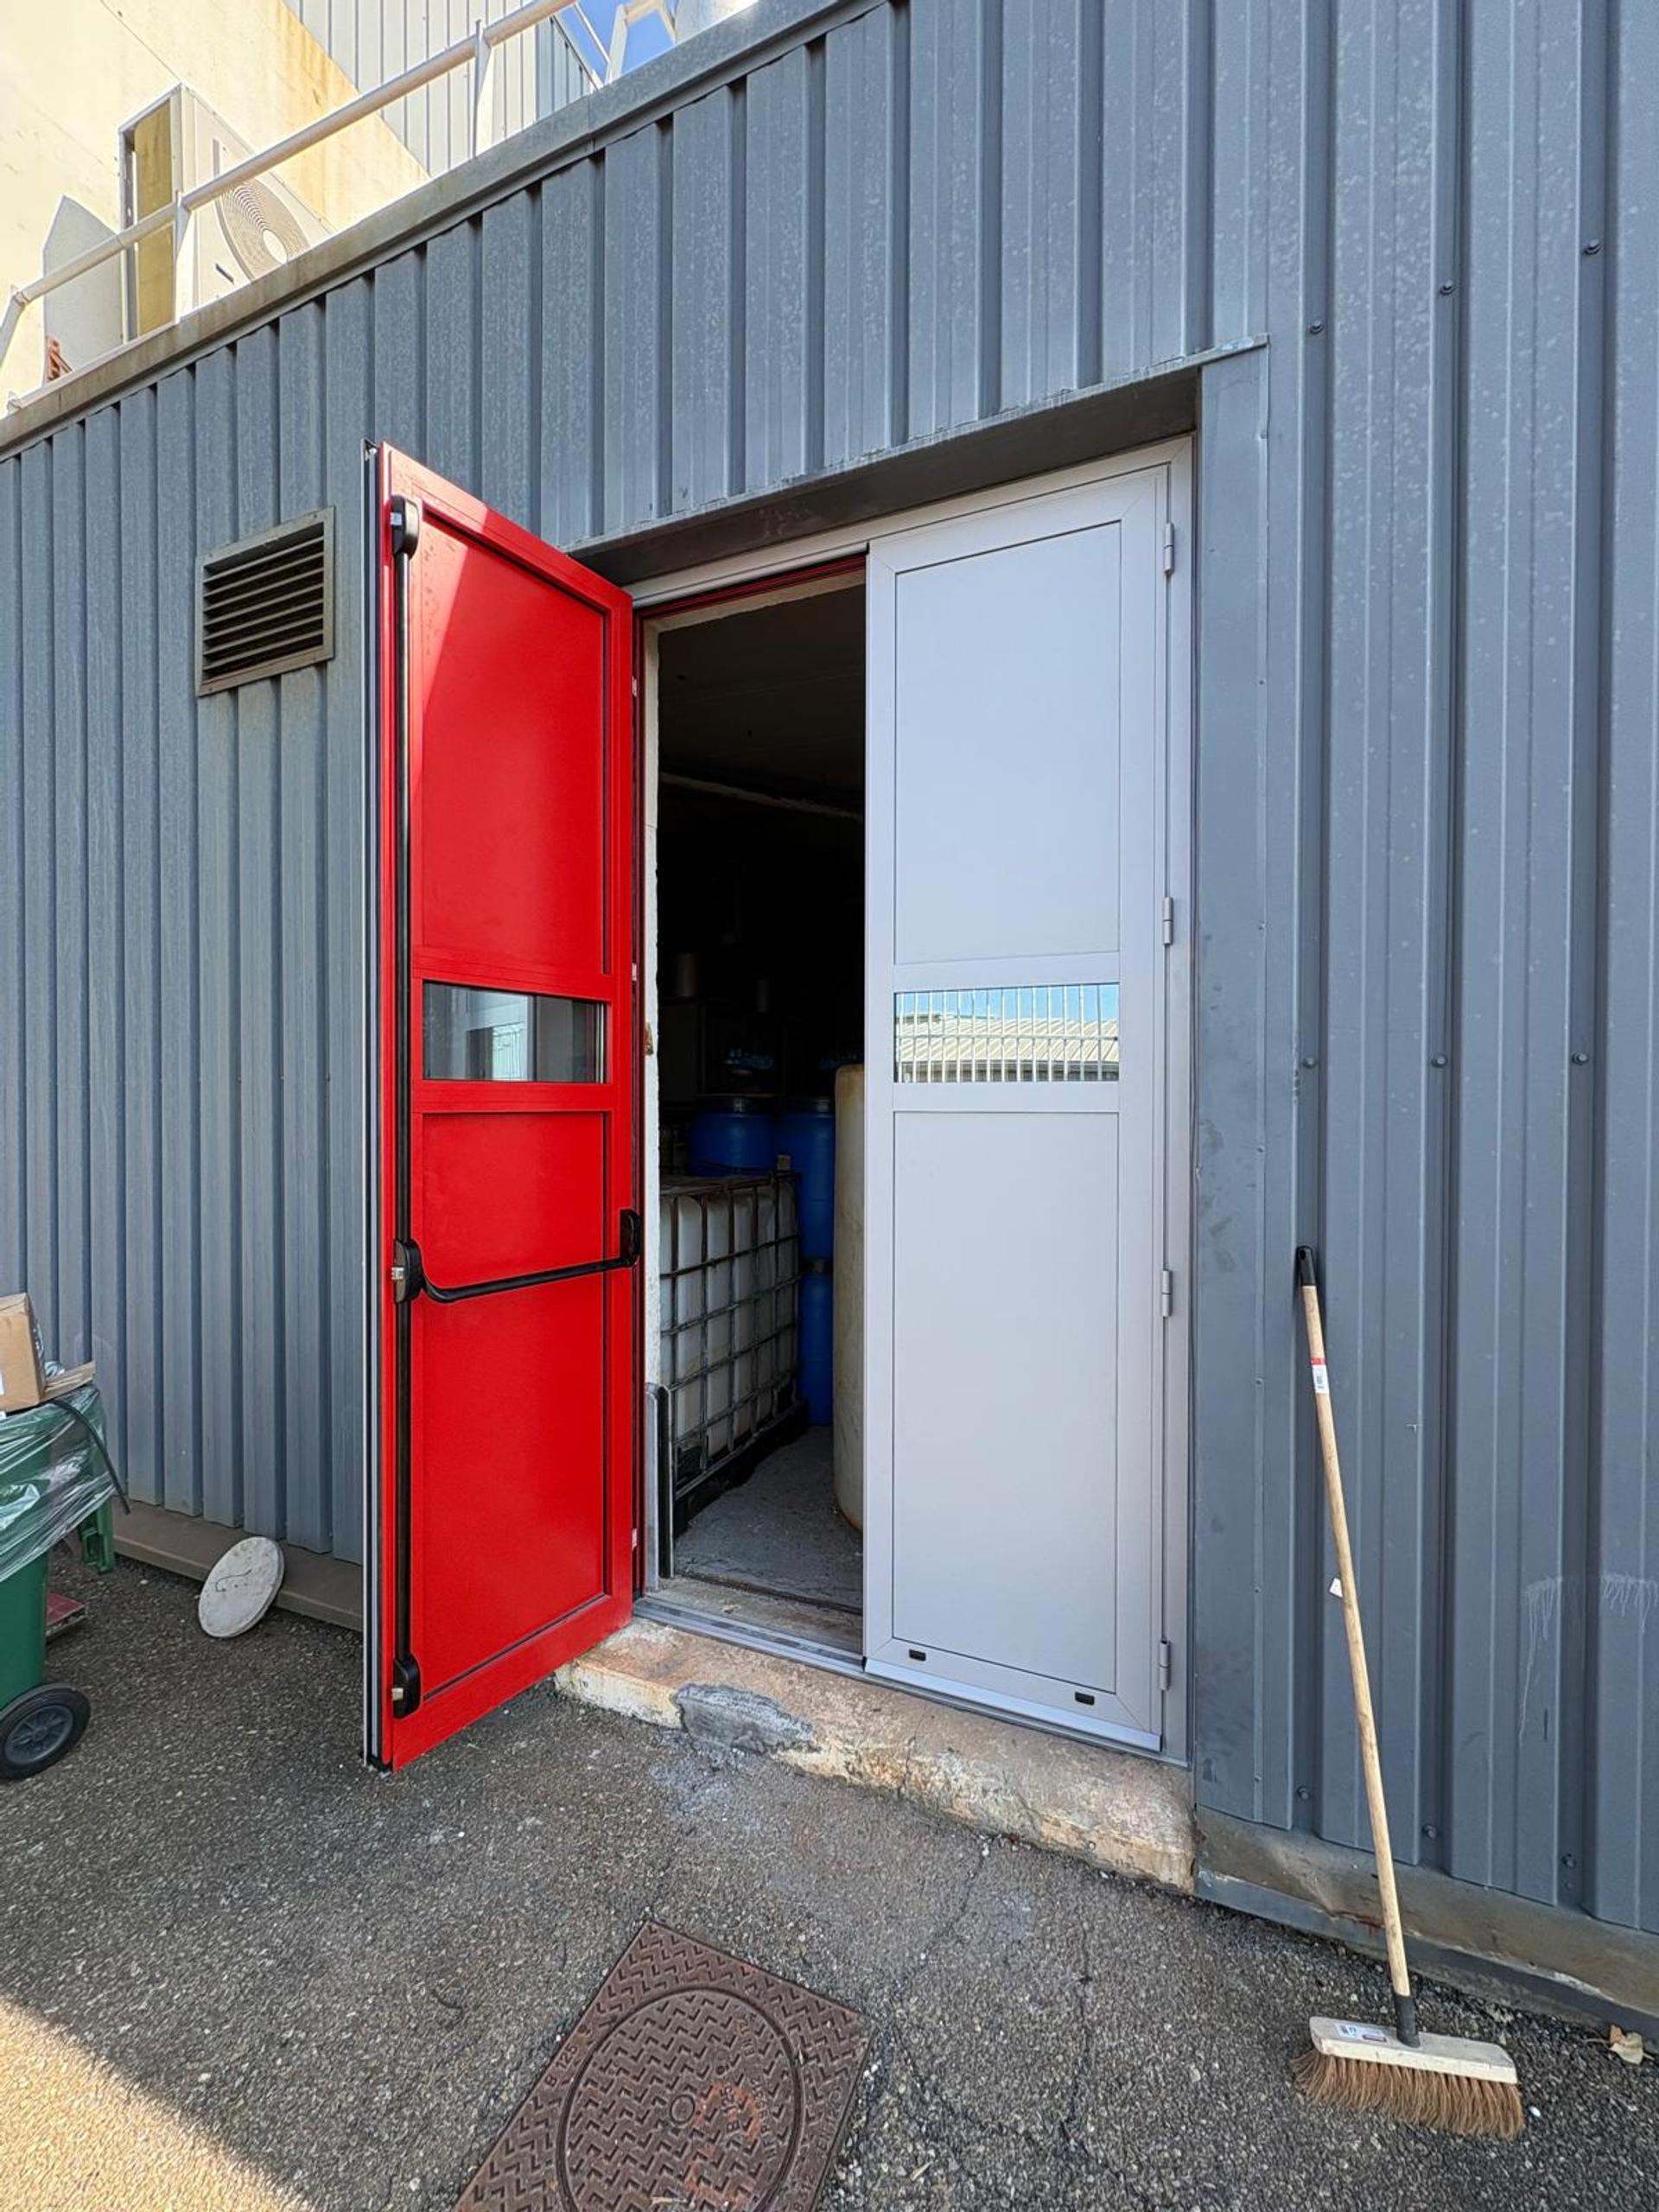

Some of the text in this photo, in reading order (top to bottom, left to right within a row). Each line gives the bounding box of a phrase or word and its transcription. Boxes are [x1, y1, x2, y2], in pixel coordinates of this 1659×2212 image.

[544, 2042, 578, 2088] B 125
[720, 2085, 741, 2133] B 125
